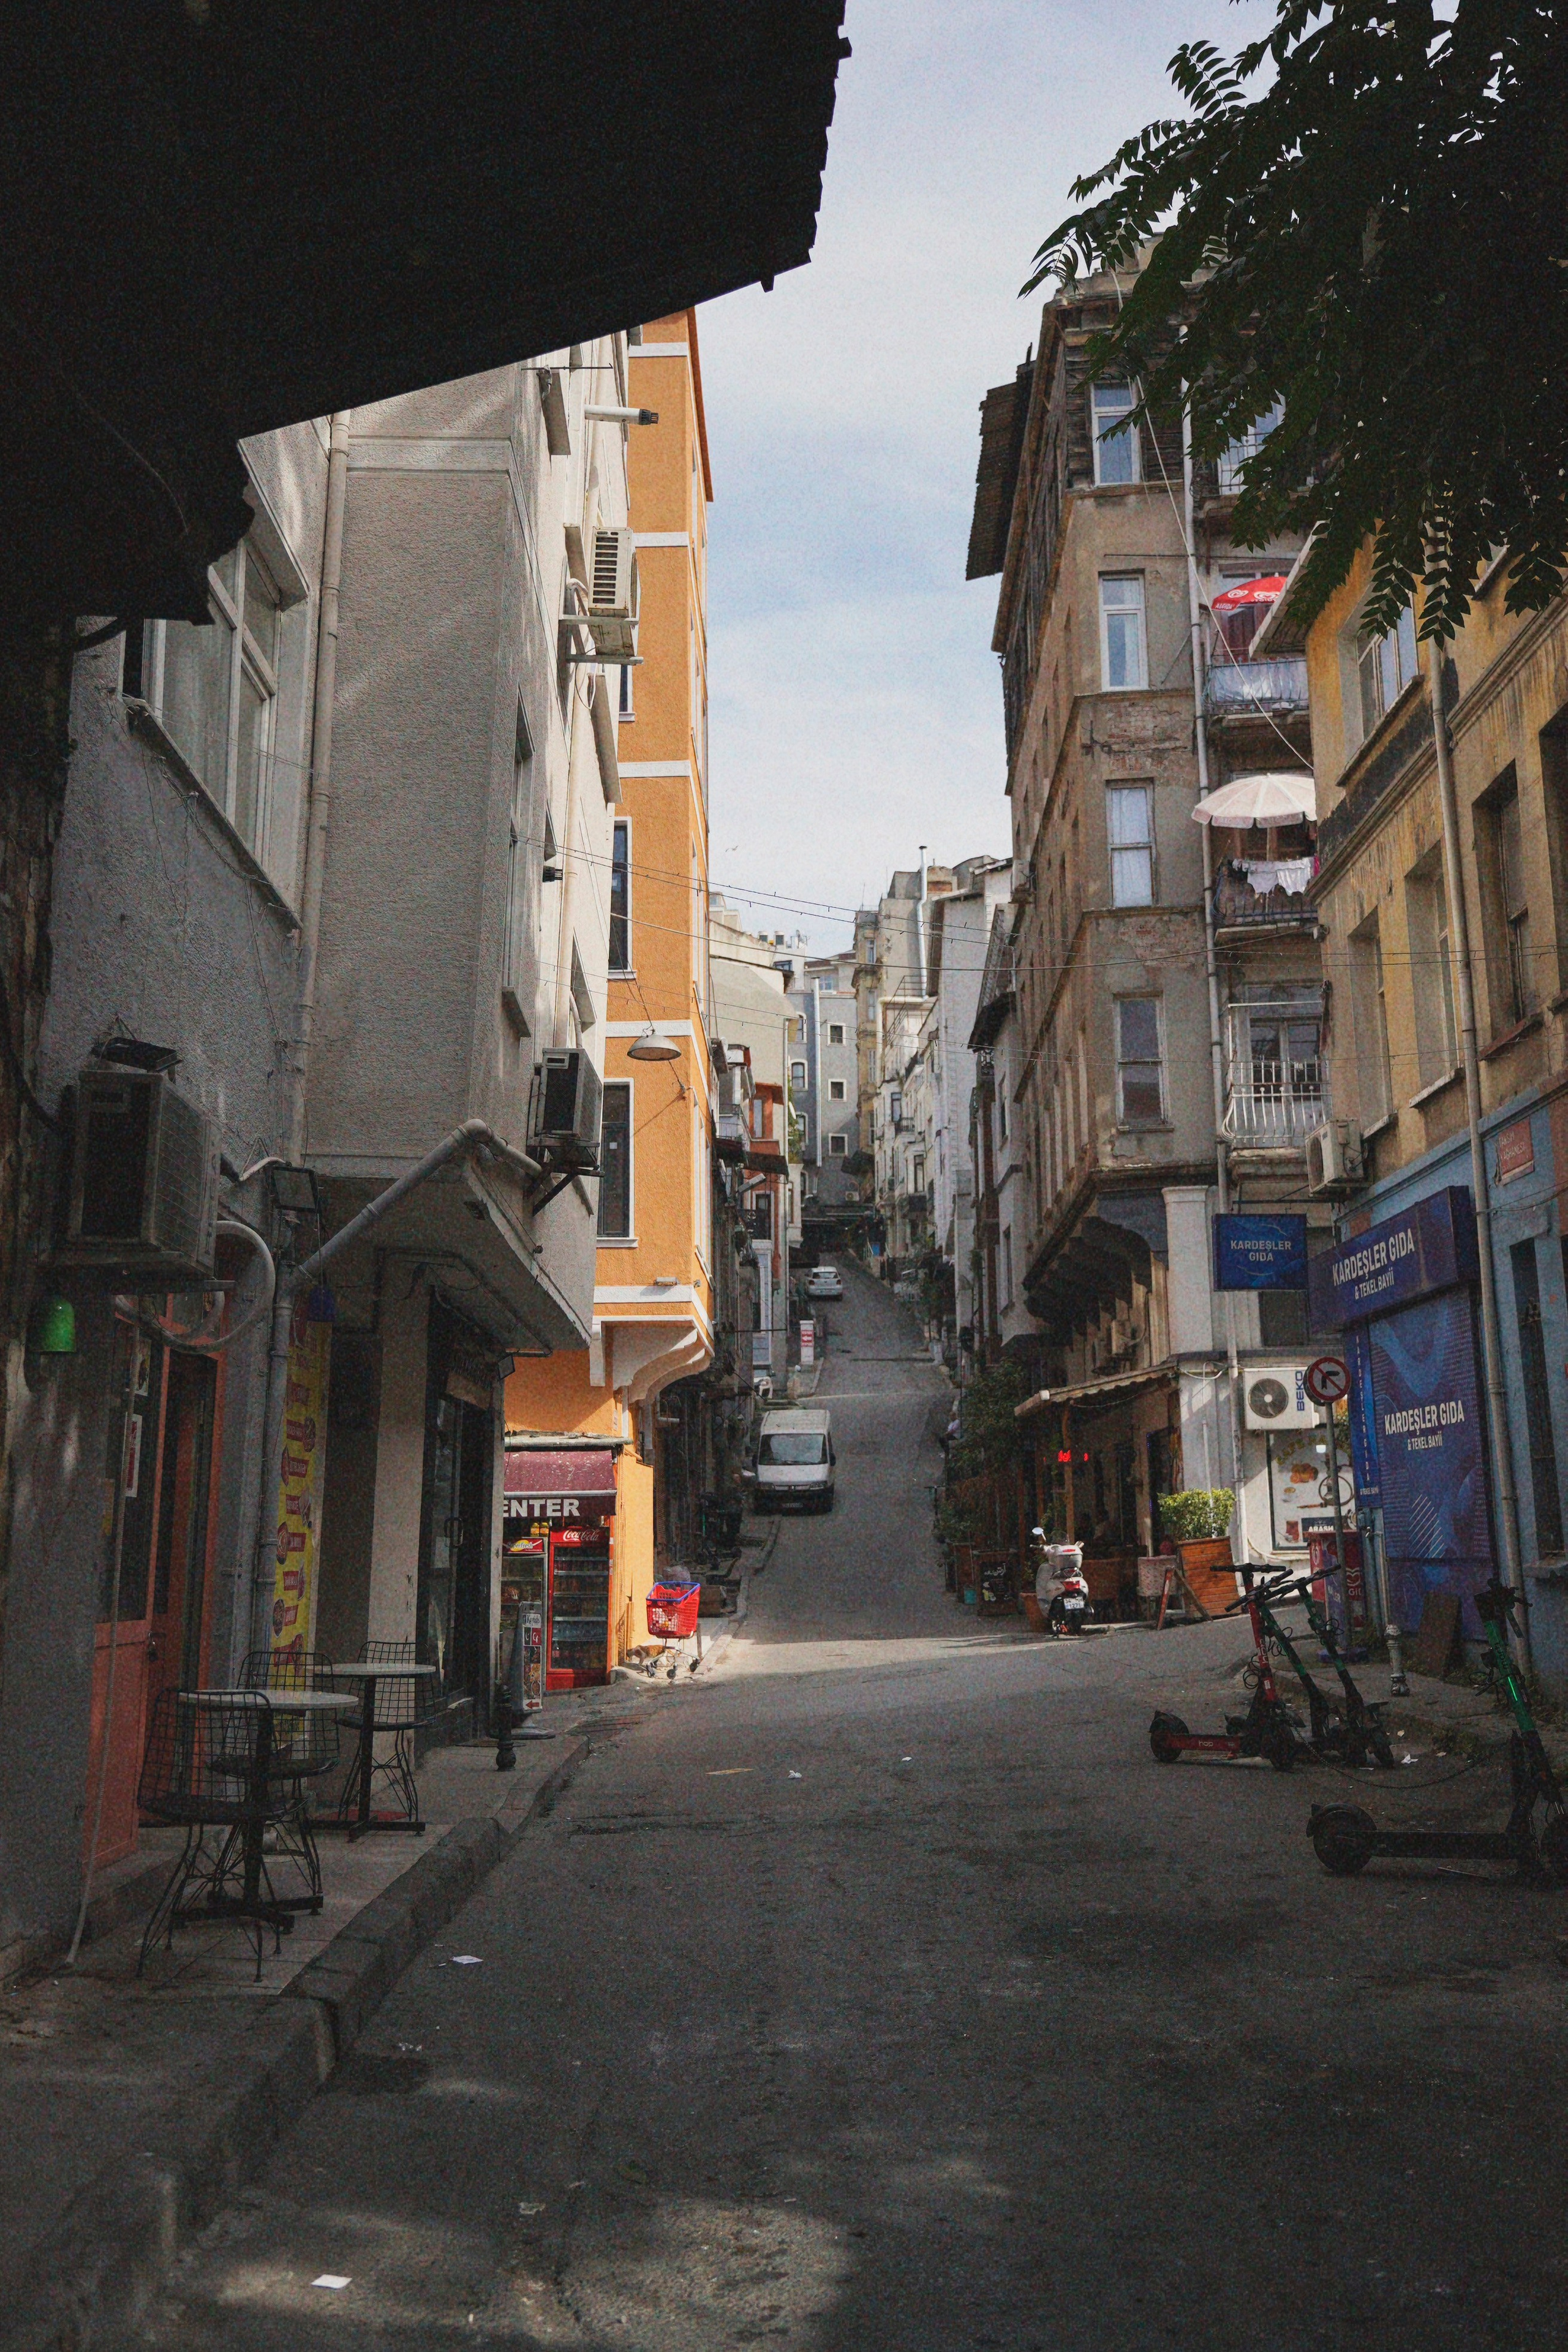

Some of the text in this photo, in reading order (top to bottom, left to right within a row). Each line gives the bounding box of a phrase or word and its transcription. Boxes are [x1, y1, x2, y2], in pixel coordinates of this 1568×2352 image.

[1230, 1240, 1292, 1253] KARDEŞLER
[1248, 1252, 1274, 1262] GIDA
[1332, 1227, 1415, 1286] KARDEŞLER GIDA
[1354, 1286, 1360, 1300] &
[1359, 1278, 1378, 1298] TEKEL
[1294, 1370, 1305, 1412] BEKO
[1384, 1400, 1465, 1436] KARDEŞLER GIDA
[1407, 1439, 1412, 1451] &
[1411, 1436, 1428, 1450] TEKEL
[562, 1528, 600, 1542] Coca-Cola
